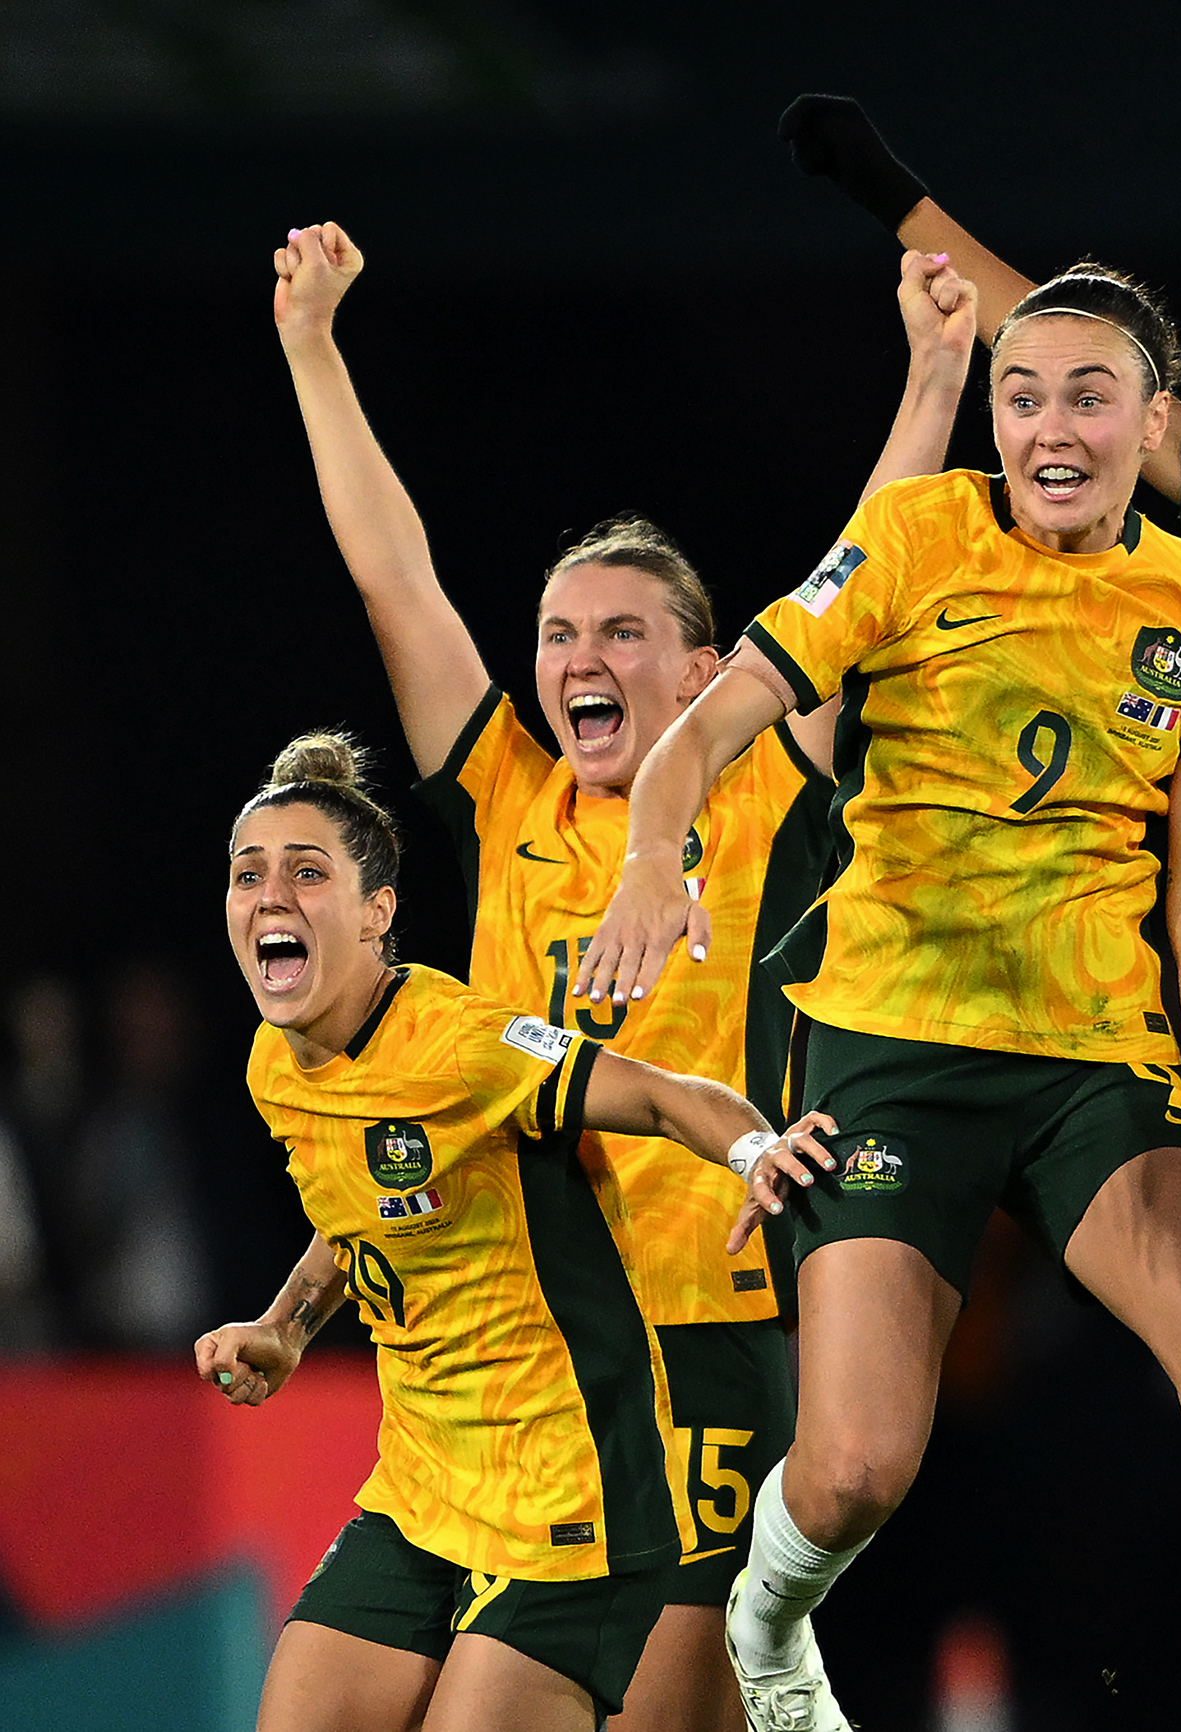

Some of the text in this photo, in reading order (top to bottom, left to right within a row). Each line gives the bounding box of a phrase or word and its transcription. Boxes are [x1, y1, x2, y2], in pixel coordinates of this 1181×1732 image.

[1140, 665, 1181, 688] AUSTRALIA
[1010, 709, 1071, 814] 9
[379, 1161, 422, 1171] AUSTRALIA
[844, 1172, 896, 1183] AUSTRALIA
[336, 1235, 406, 1328] 19
